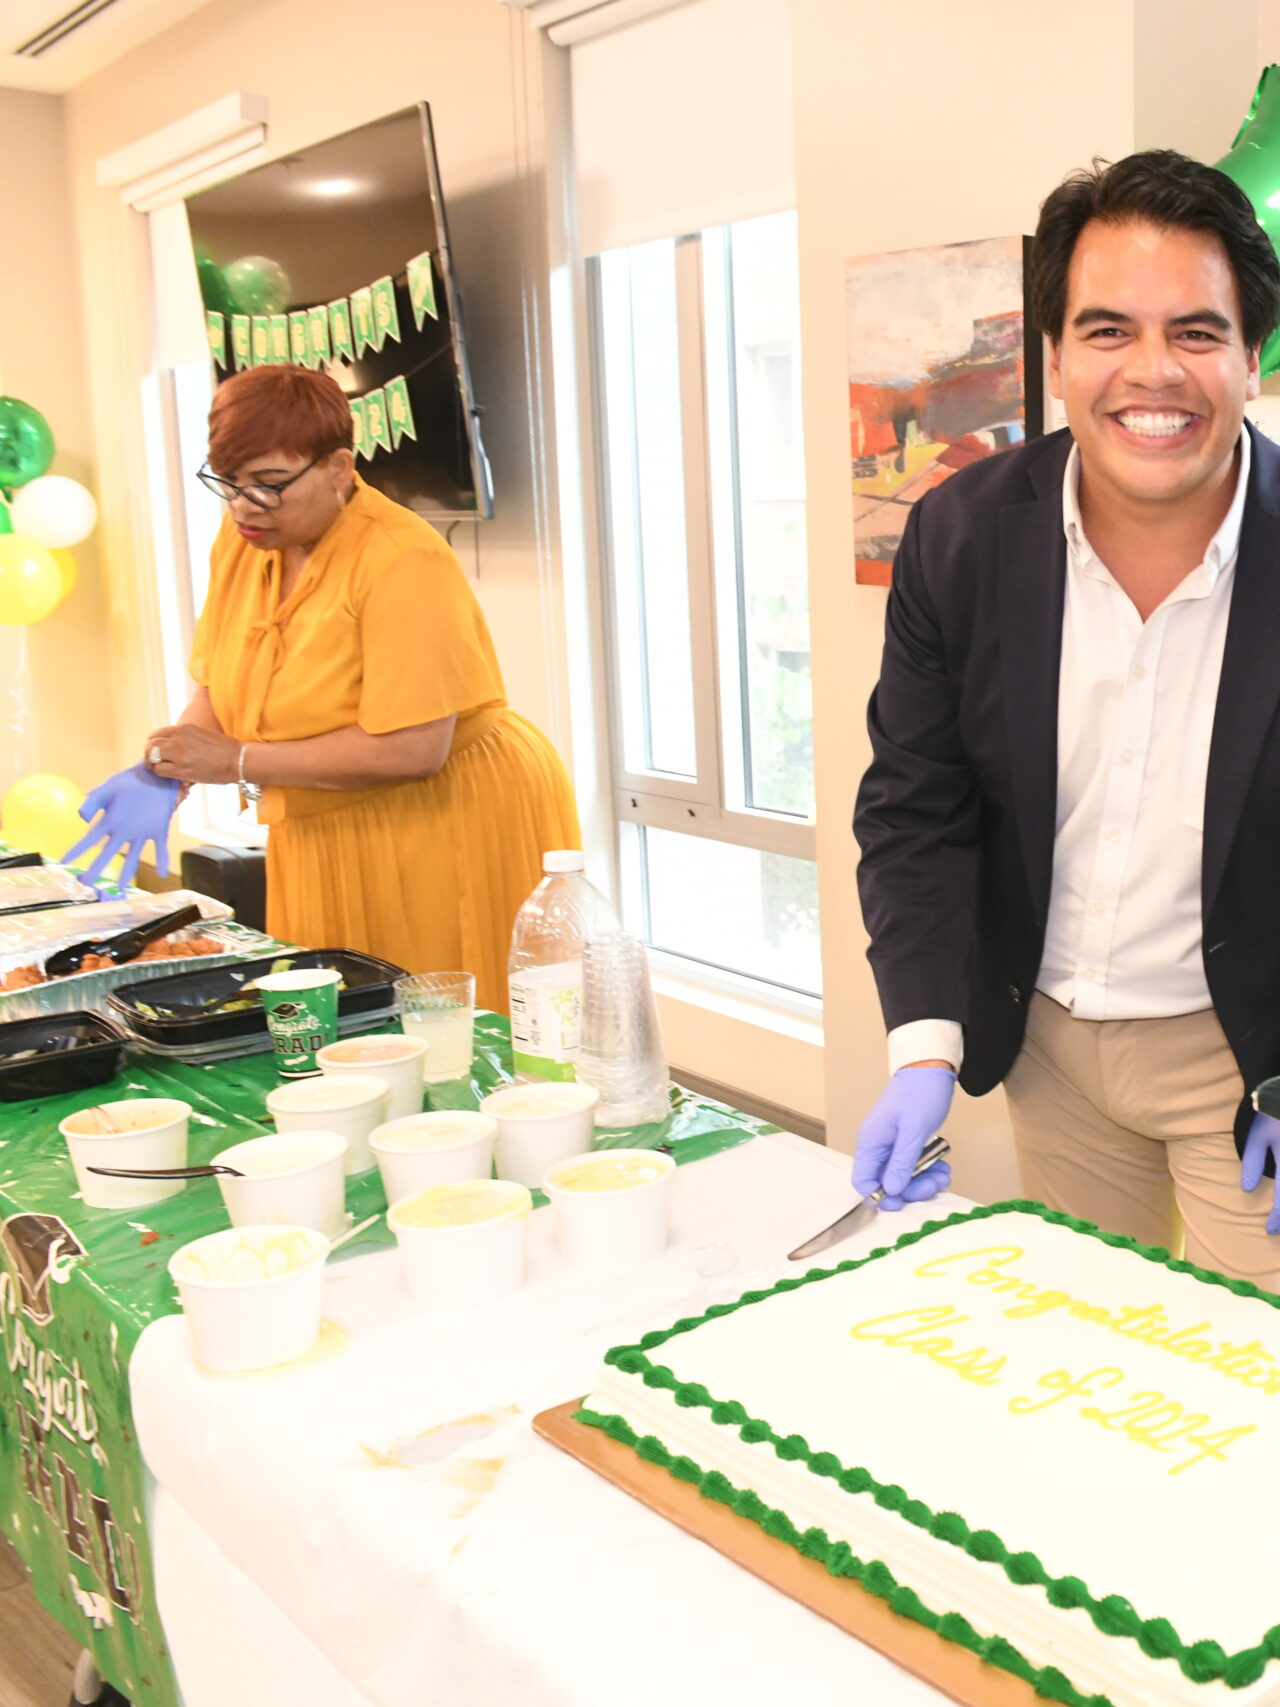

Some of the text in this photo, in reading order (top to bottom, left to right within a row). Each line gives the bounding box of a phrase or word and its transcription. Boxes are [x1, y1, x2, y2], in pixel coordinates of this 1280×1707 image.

[235, 291, 390, 359] CONGRATS
[850, 1304, 1258, 1476] Class of 2024
